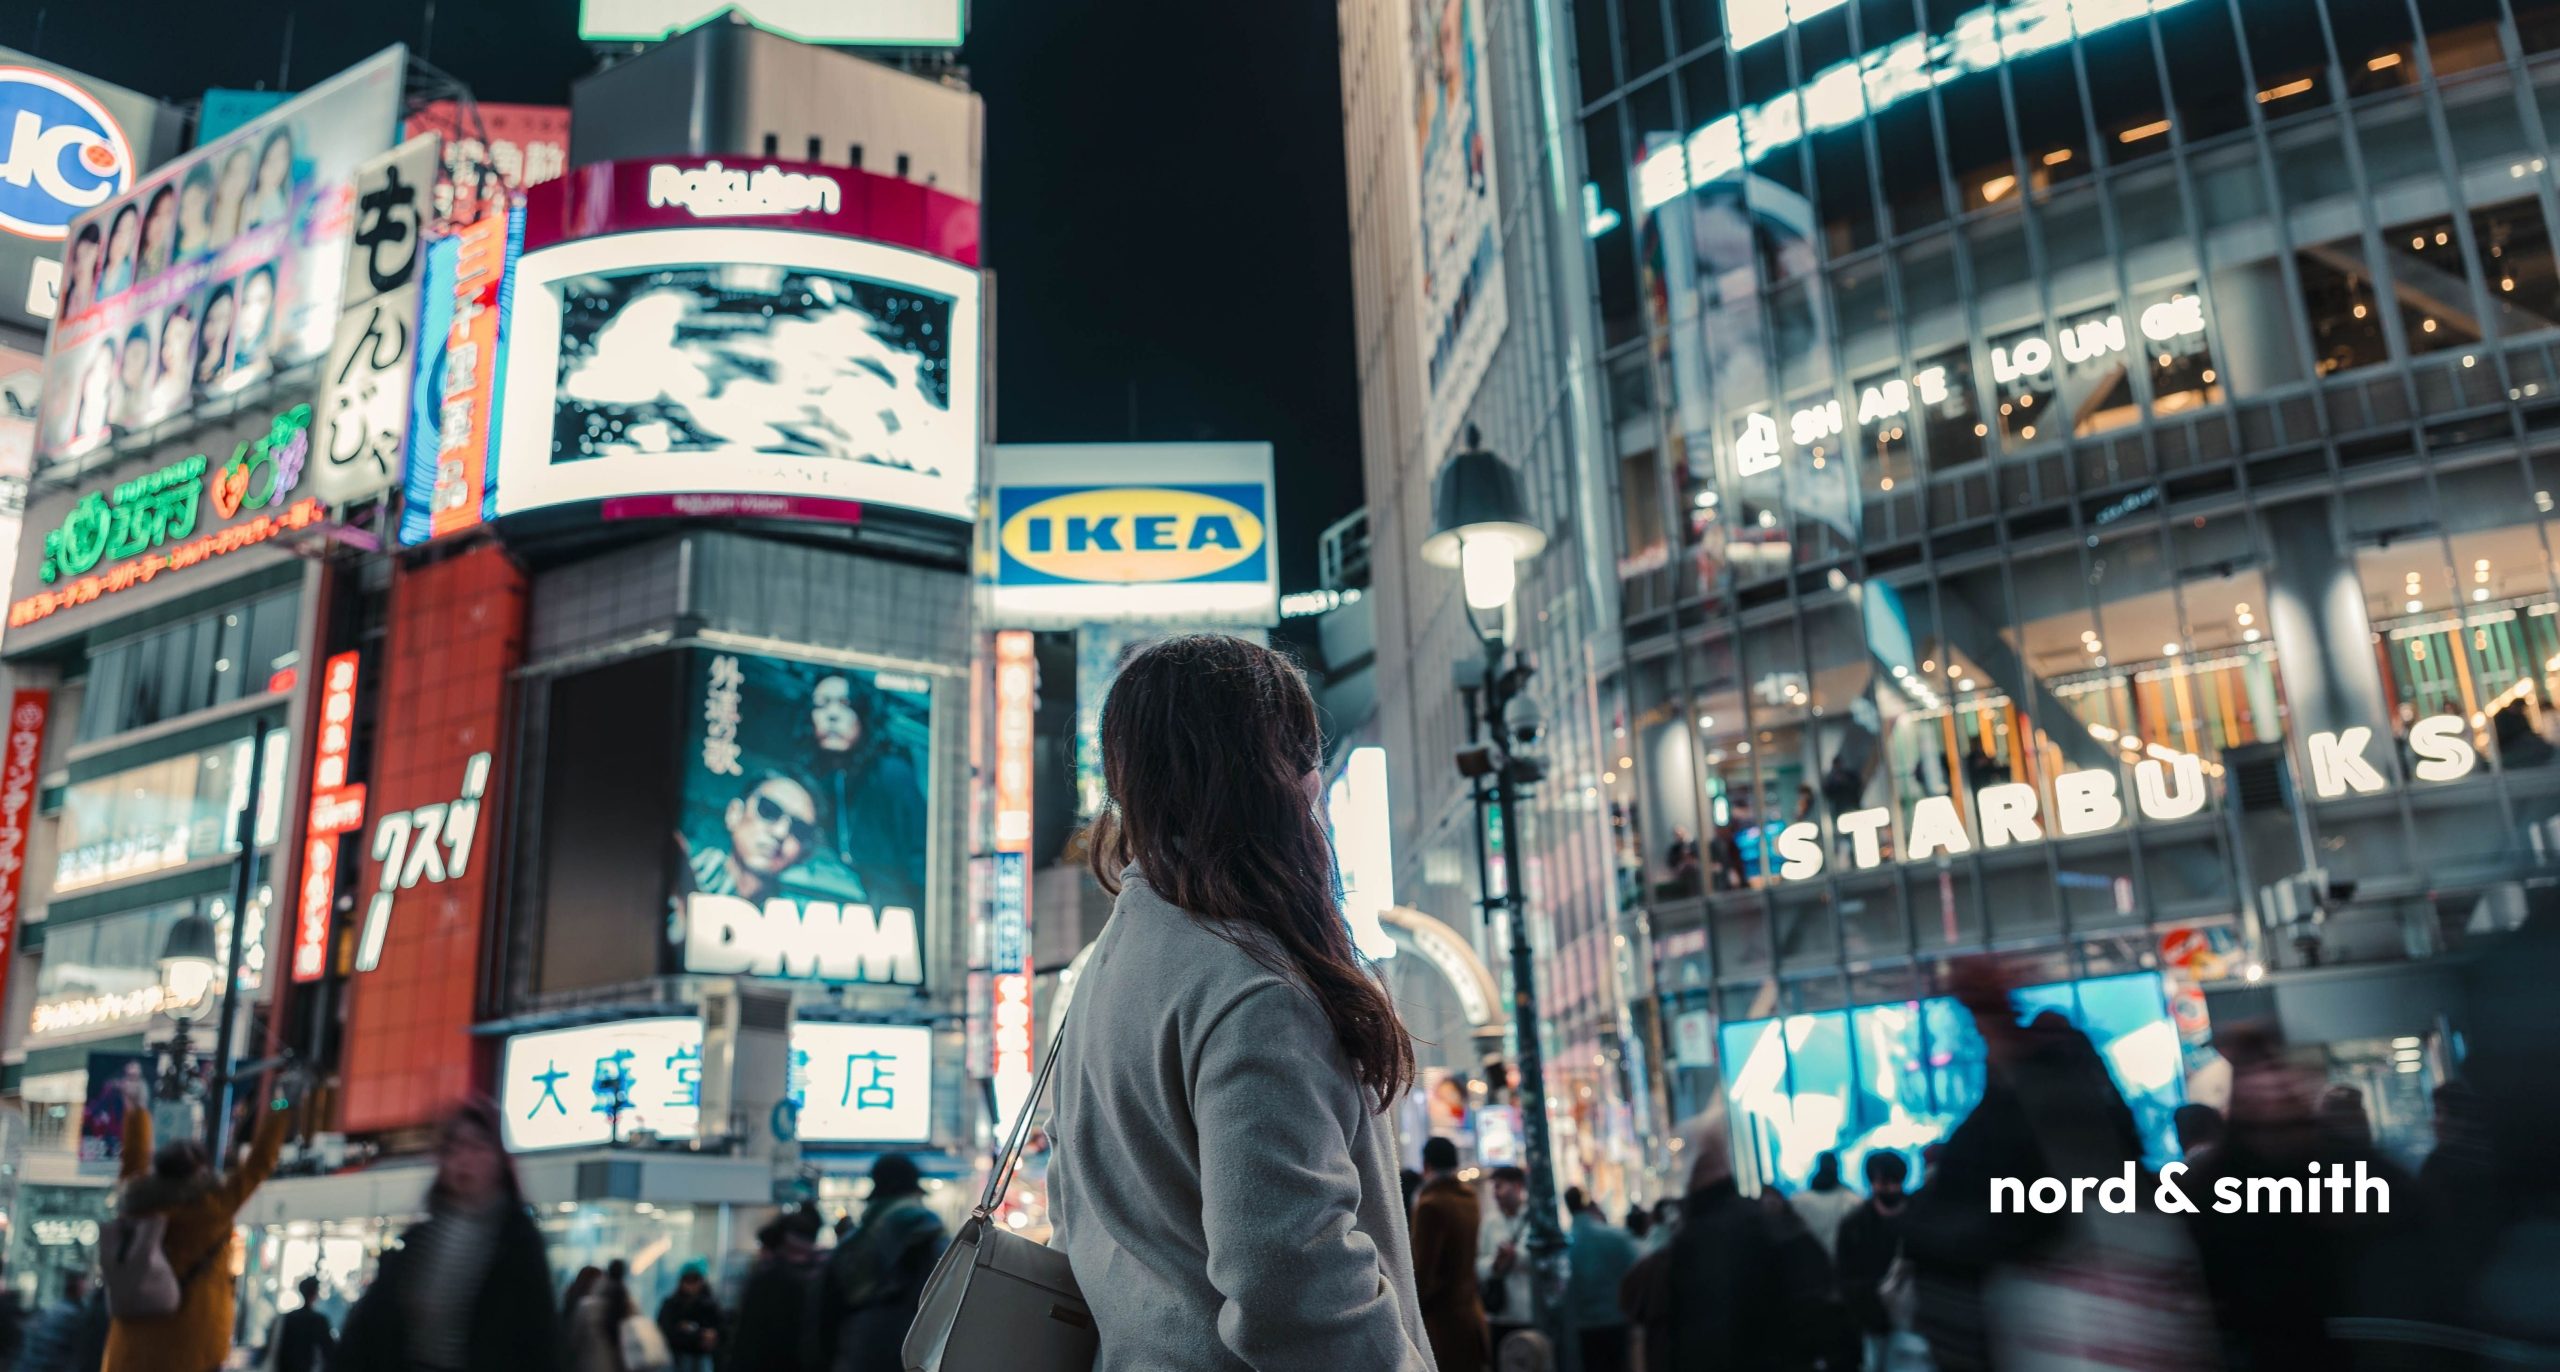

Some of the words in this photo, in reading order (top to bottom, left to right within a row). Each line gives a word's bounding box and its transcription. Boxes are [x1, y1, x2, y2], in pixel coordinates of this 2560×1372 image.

[649, 161, 840, 216] Rakuten
[330, 166, 421, 475] もんじゃ
[1791, 366, 1947, 446] SHARE
[1991, 295, 2205, 384] LOUNGE
[1028, 515, 1244, 553] IKEA
[1778, 714, 2476, 881] STARBUKS
[684, 892, 924, 985] DMM
